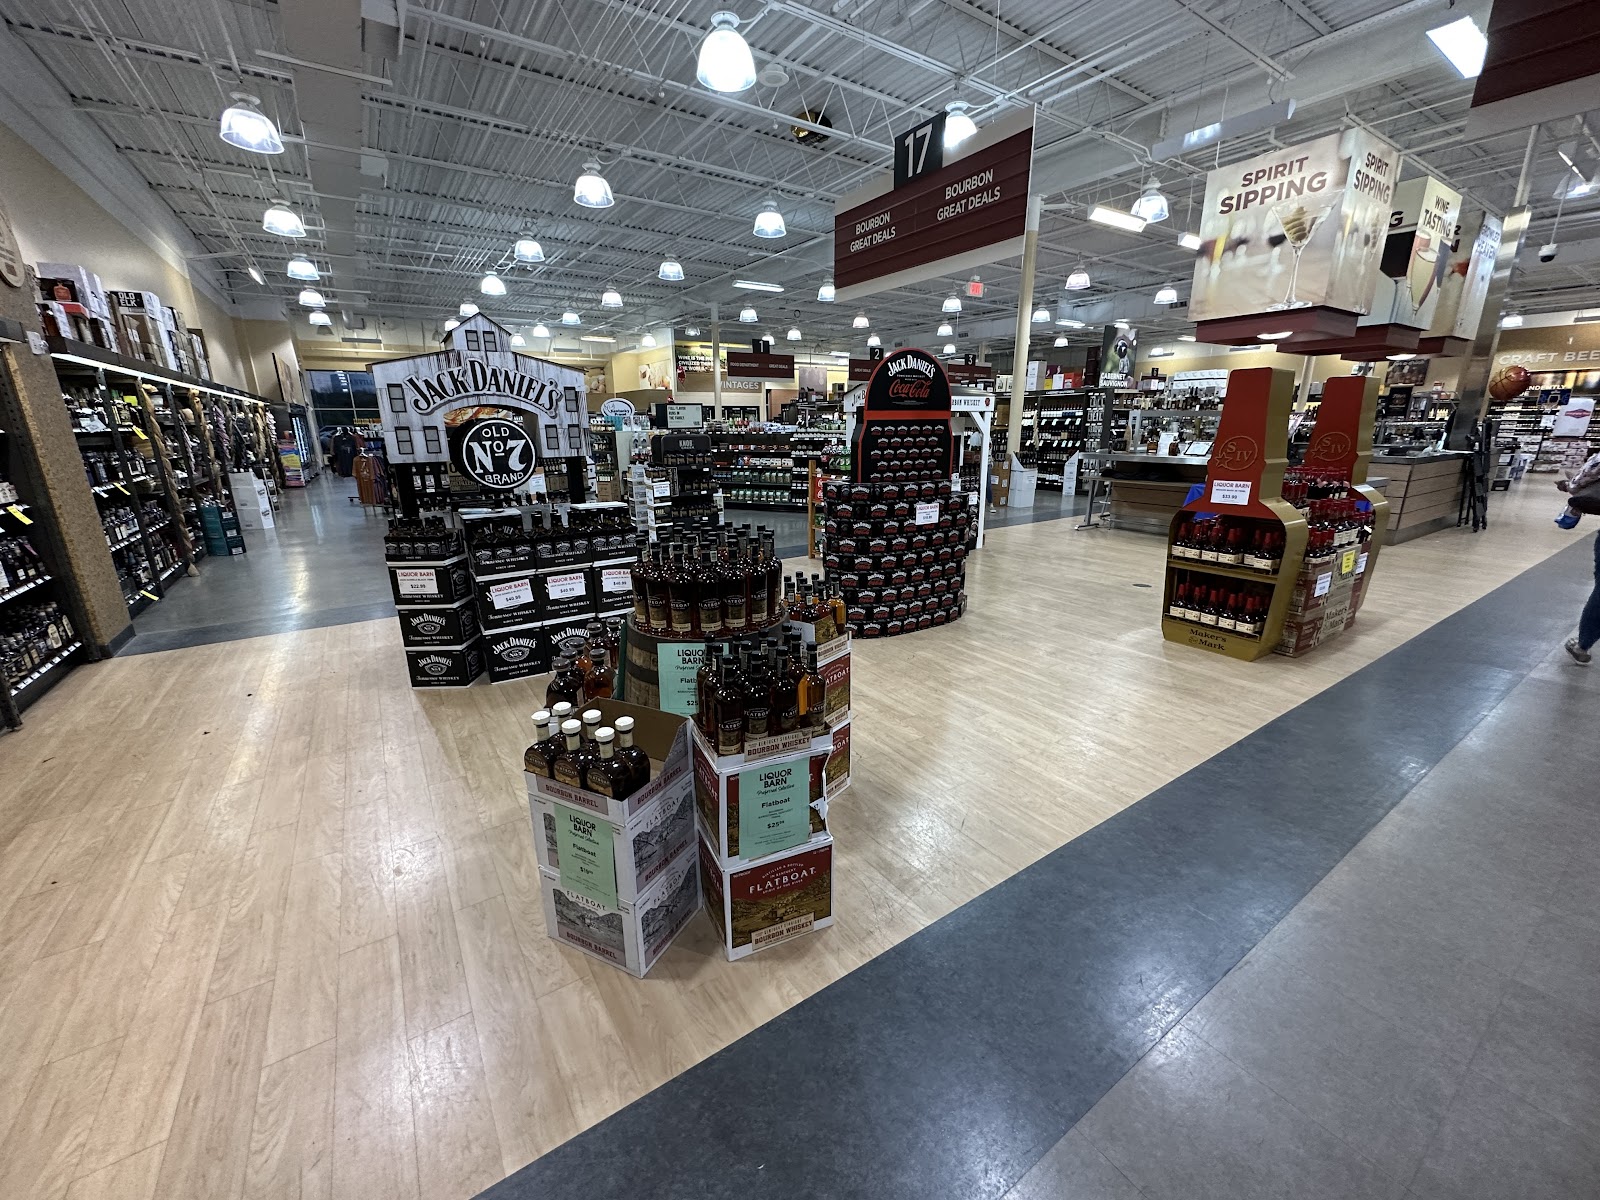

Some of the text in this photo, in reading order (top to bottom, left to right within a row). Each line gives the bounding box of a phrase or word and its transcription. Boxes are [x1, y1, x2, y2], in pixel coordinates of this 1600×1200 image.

[904, 123, 933, 178] 17
[1241, 156, 1309, 188] SPIRIT
[1365, 152, 1389, 176] SPIRIT
[946, 168, 993, 200] BOURBON
[1353, 169, 1391, 204] SIPPING
[1218, 171, 1328, 215] SIPPING
[937, 186, 1000, 222] GREAT DEALS
[1434, 195, 1450, 212] WINE
[855, 212, 890, 235] BOURBON
[1423, 209, 1452, 238] TASTING
[850, 226, 896, 252] GREAT DEALS
[118, 292, 135, 300] OLD
[120, 299, 137, 307] ELK
[759, 340, 764, 352] 1
[874, 349, 880, 360] 2
[968, 355, 973, 365] 3
[1499, 350, 1600, 365] CRAFT BEE
[888, 358, 906, 377] JACK
[906, 354, 936, 380] DANIEL'S
[1100, 372, 1126, 380] CABERNET
[1100, 380, 1128, 388] SAUVIGNON
[405, 360, 562, 416] JACK DANIEL'S
[889, 378, 933, 398] Coca-Cola
[482, 426, 510, 438] OLD
[506, 440, 526, 472] 7
[484, 472, 524, 484] BRAND
[410, 613, 446, 626] JACK DANIEL'S
[550, 630, 566, 644] JACK
[1189, 628, 1226, 643] Maker's
[492, 637, 537, 654] JACK DANIEL'S
[1198, 639, 1225, 651] Mark
[418, 655, 453, 668] JACK DANIEL'S
[826, 667, 849, 684] ATBOAT
[748, 737, 810, 756] BOURBON WHISKEY
[759, 768, 792, 781] LIQUOR
[764, 778, 787, 788] BARN
[637, 766, 682, 805] BOURBON BARREL
[757, 787, 777, 796] Preferred
[545, 784, 598, 808] BOURBON BARREL
[762, 797, 790, 808] Flatboat
[646, 797, 680, 829] FLATBOAT
[570, 814, 596, 831] LIQUOR
[573, 824, 592, 838] BARN
[572, 843, 596, 857] Flatboat
[644, 839, 688, 882] BOURBON BARREL
[750, 867, 816, 894] FLATBOAT
[762, 866, 782, 878] DISTILLED
[775, 868, 796, 877] KENTUCKY
[653, 870, 685, 904] FLATBOAT
[566, 891, 606, 911] FLATBOAT
[755, 920, 813, 944] BOURBON WHISKEY
[566, 932, 617, 960] BOURBON BARREL
